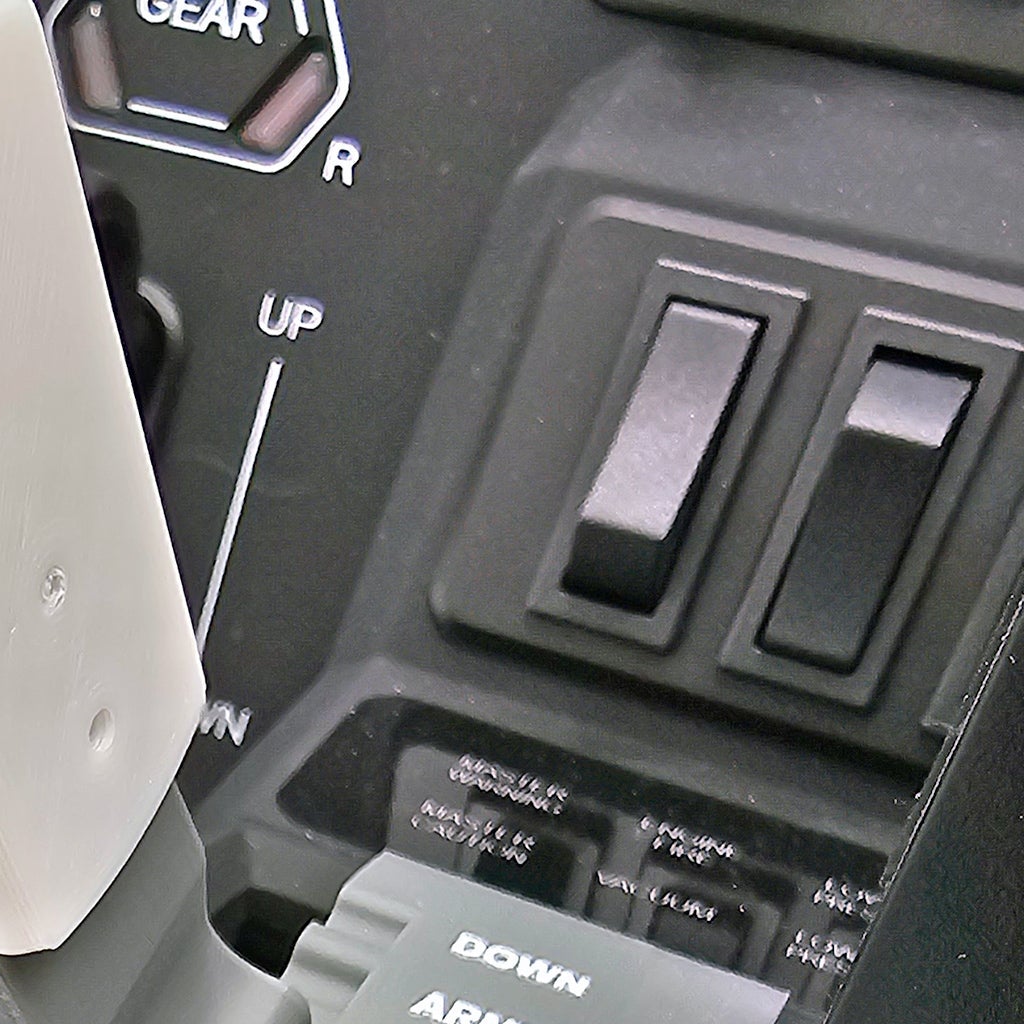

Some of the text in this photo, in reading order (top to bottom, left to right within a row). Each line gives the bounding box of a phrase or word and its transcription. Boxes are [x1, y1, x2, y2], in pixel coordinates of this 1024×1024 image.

[136, 0, 269, 45] GEAR
[322, 135, 362, 187] R
[257, 288, 325, 341] UP
[449, 932, 593, 998] DOWN
